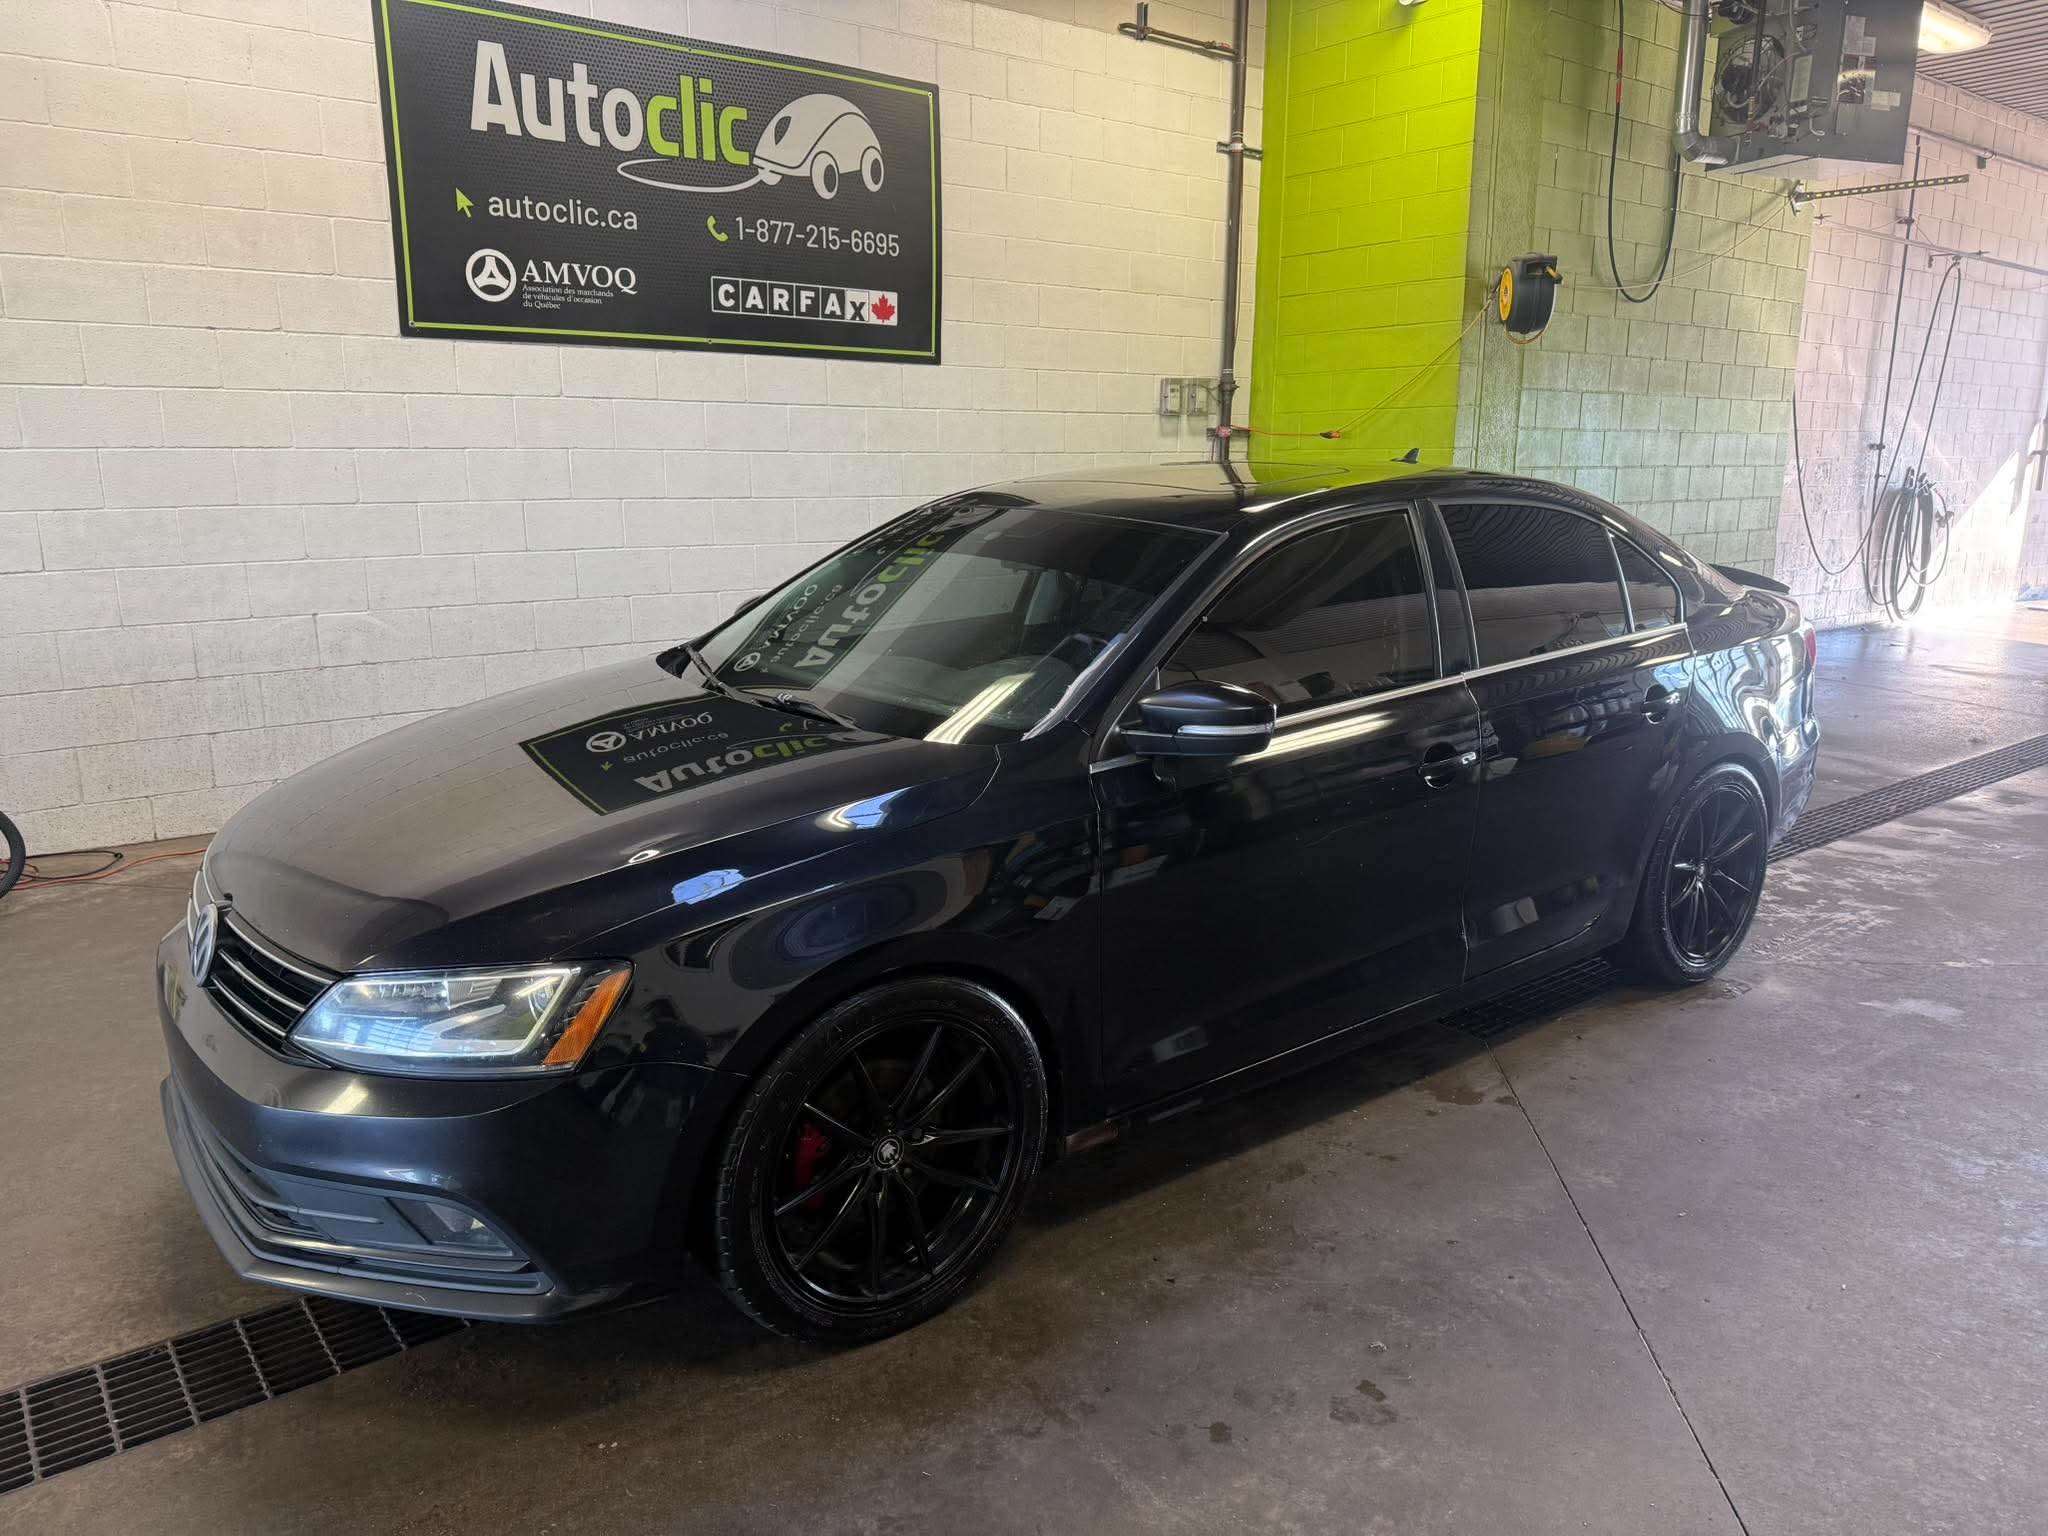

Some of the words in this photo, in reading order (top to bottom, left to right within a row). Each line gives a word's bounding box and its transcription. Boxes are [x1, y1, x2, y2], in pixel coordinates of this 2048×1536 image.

[471, 40, 750, 166] Autoclic
[488, 195, 638, 230] autoclic.ca
[735, 216, 899, 257] 1-877-215-6695
[521, 259, 638, 295] AMVOQ
[522, 284, 562, 294] Association
[564, 286, 576, 295] des
[577, 288, 614, 297] marchands
[523, 300, 533, 308] du
[718, 283, 866, 321] CARFAX
